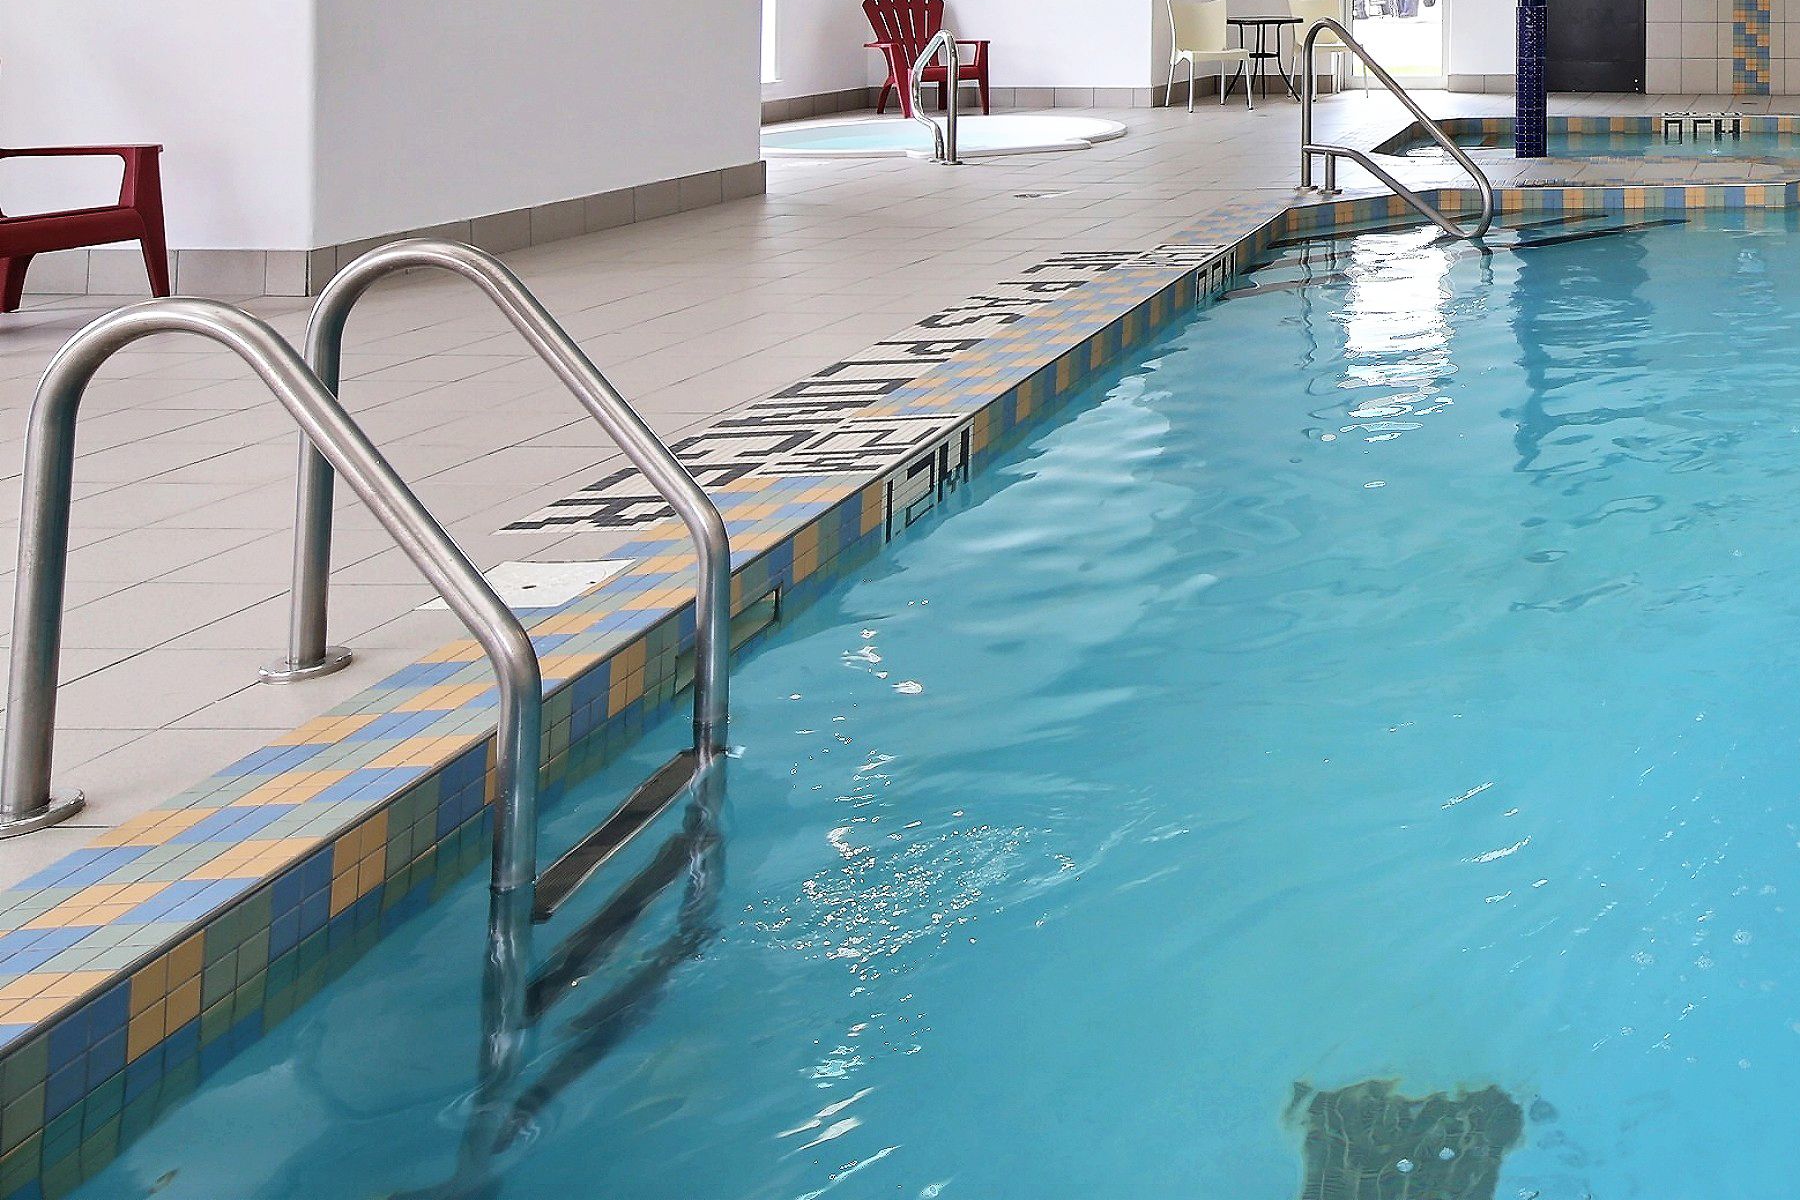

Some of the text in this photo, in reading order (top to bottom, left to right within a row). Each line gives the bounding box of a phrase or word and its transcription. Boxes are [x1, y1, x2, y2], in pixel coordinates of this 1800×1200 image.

[500, 251, 1143, 530] NE PAS PLONGER
